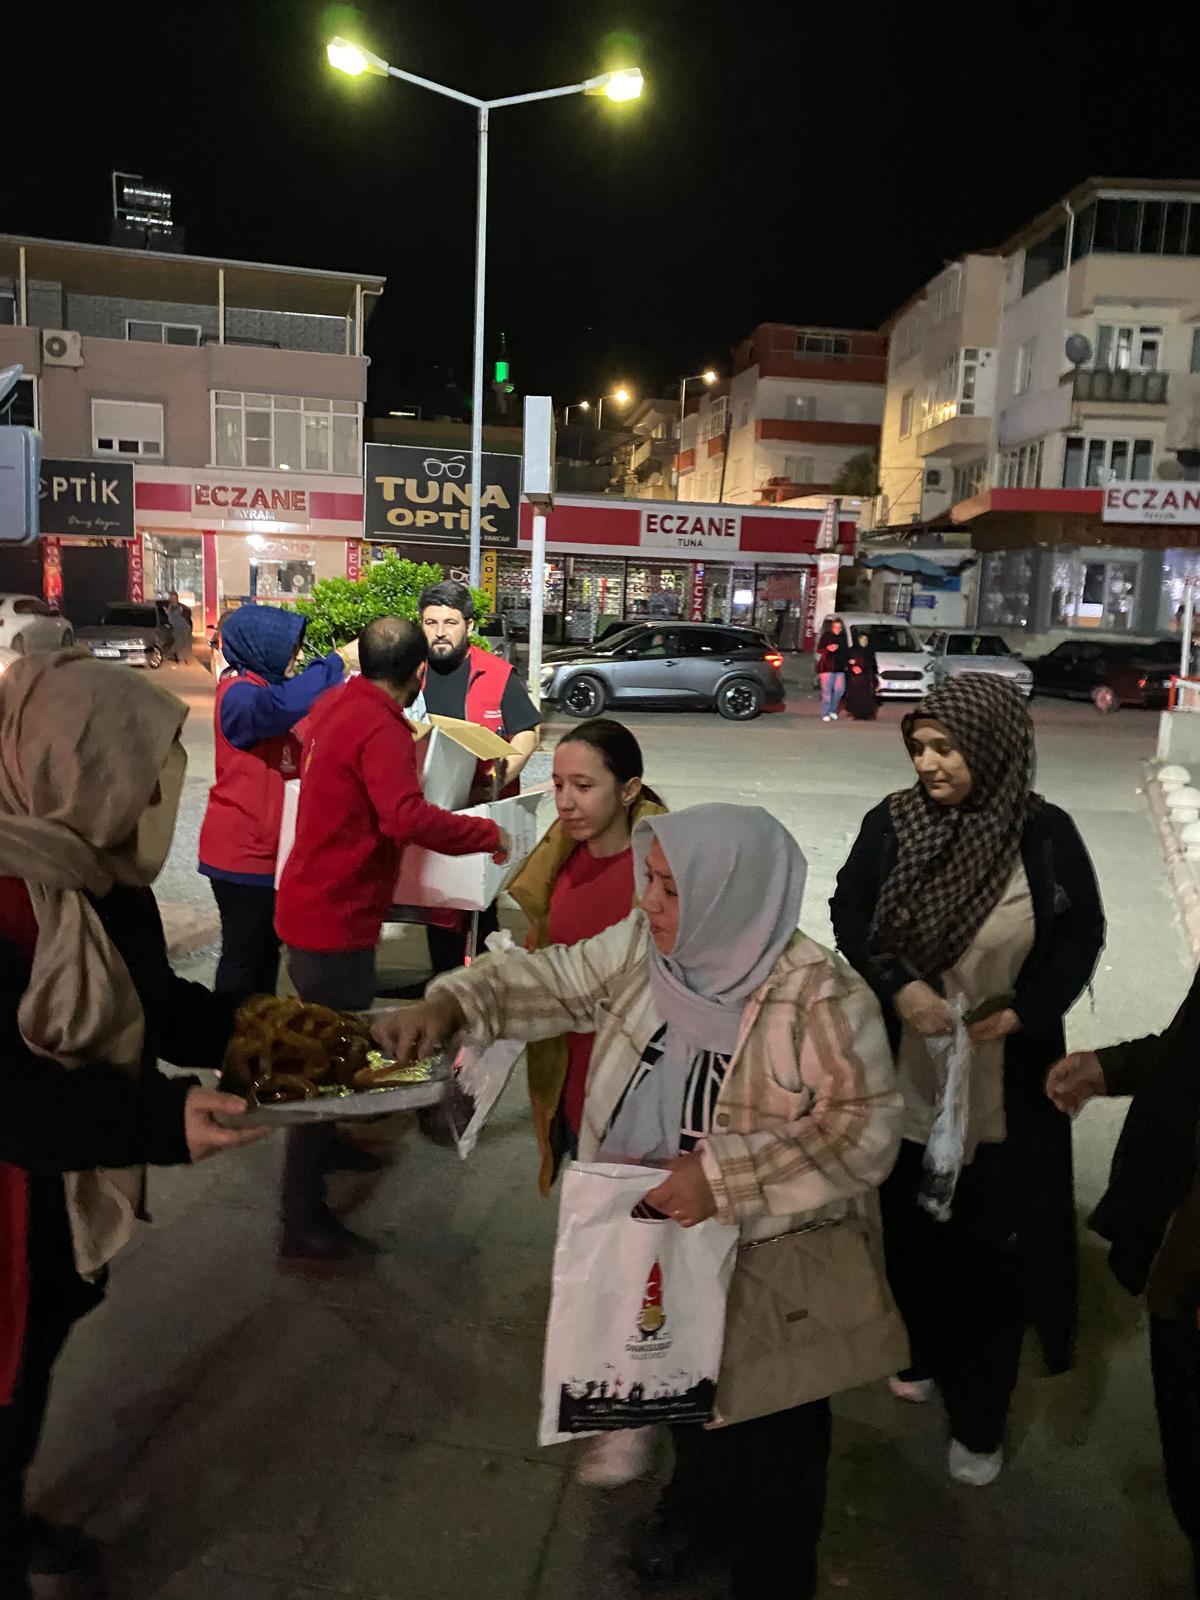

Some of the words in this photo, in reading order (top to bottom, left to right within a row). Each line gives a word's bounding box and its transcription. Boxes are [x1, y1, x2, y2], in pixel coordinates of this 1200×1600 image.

[194, 484, 306, 511] ECZANE
[375, 476, 511, 509] TUNA
[646, 513, 736, 537] ECZANE
[677, 538, 704, 548] TUNA
